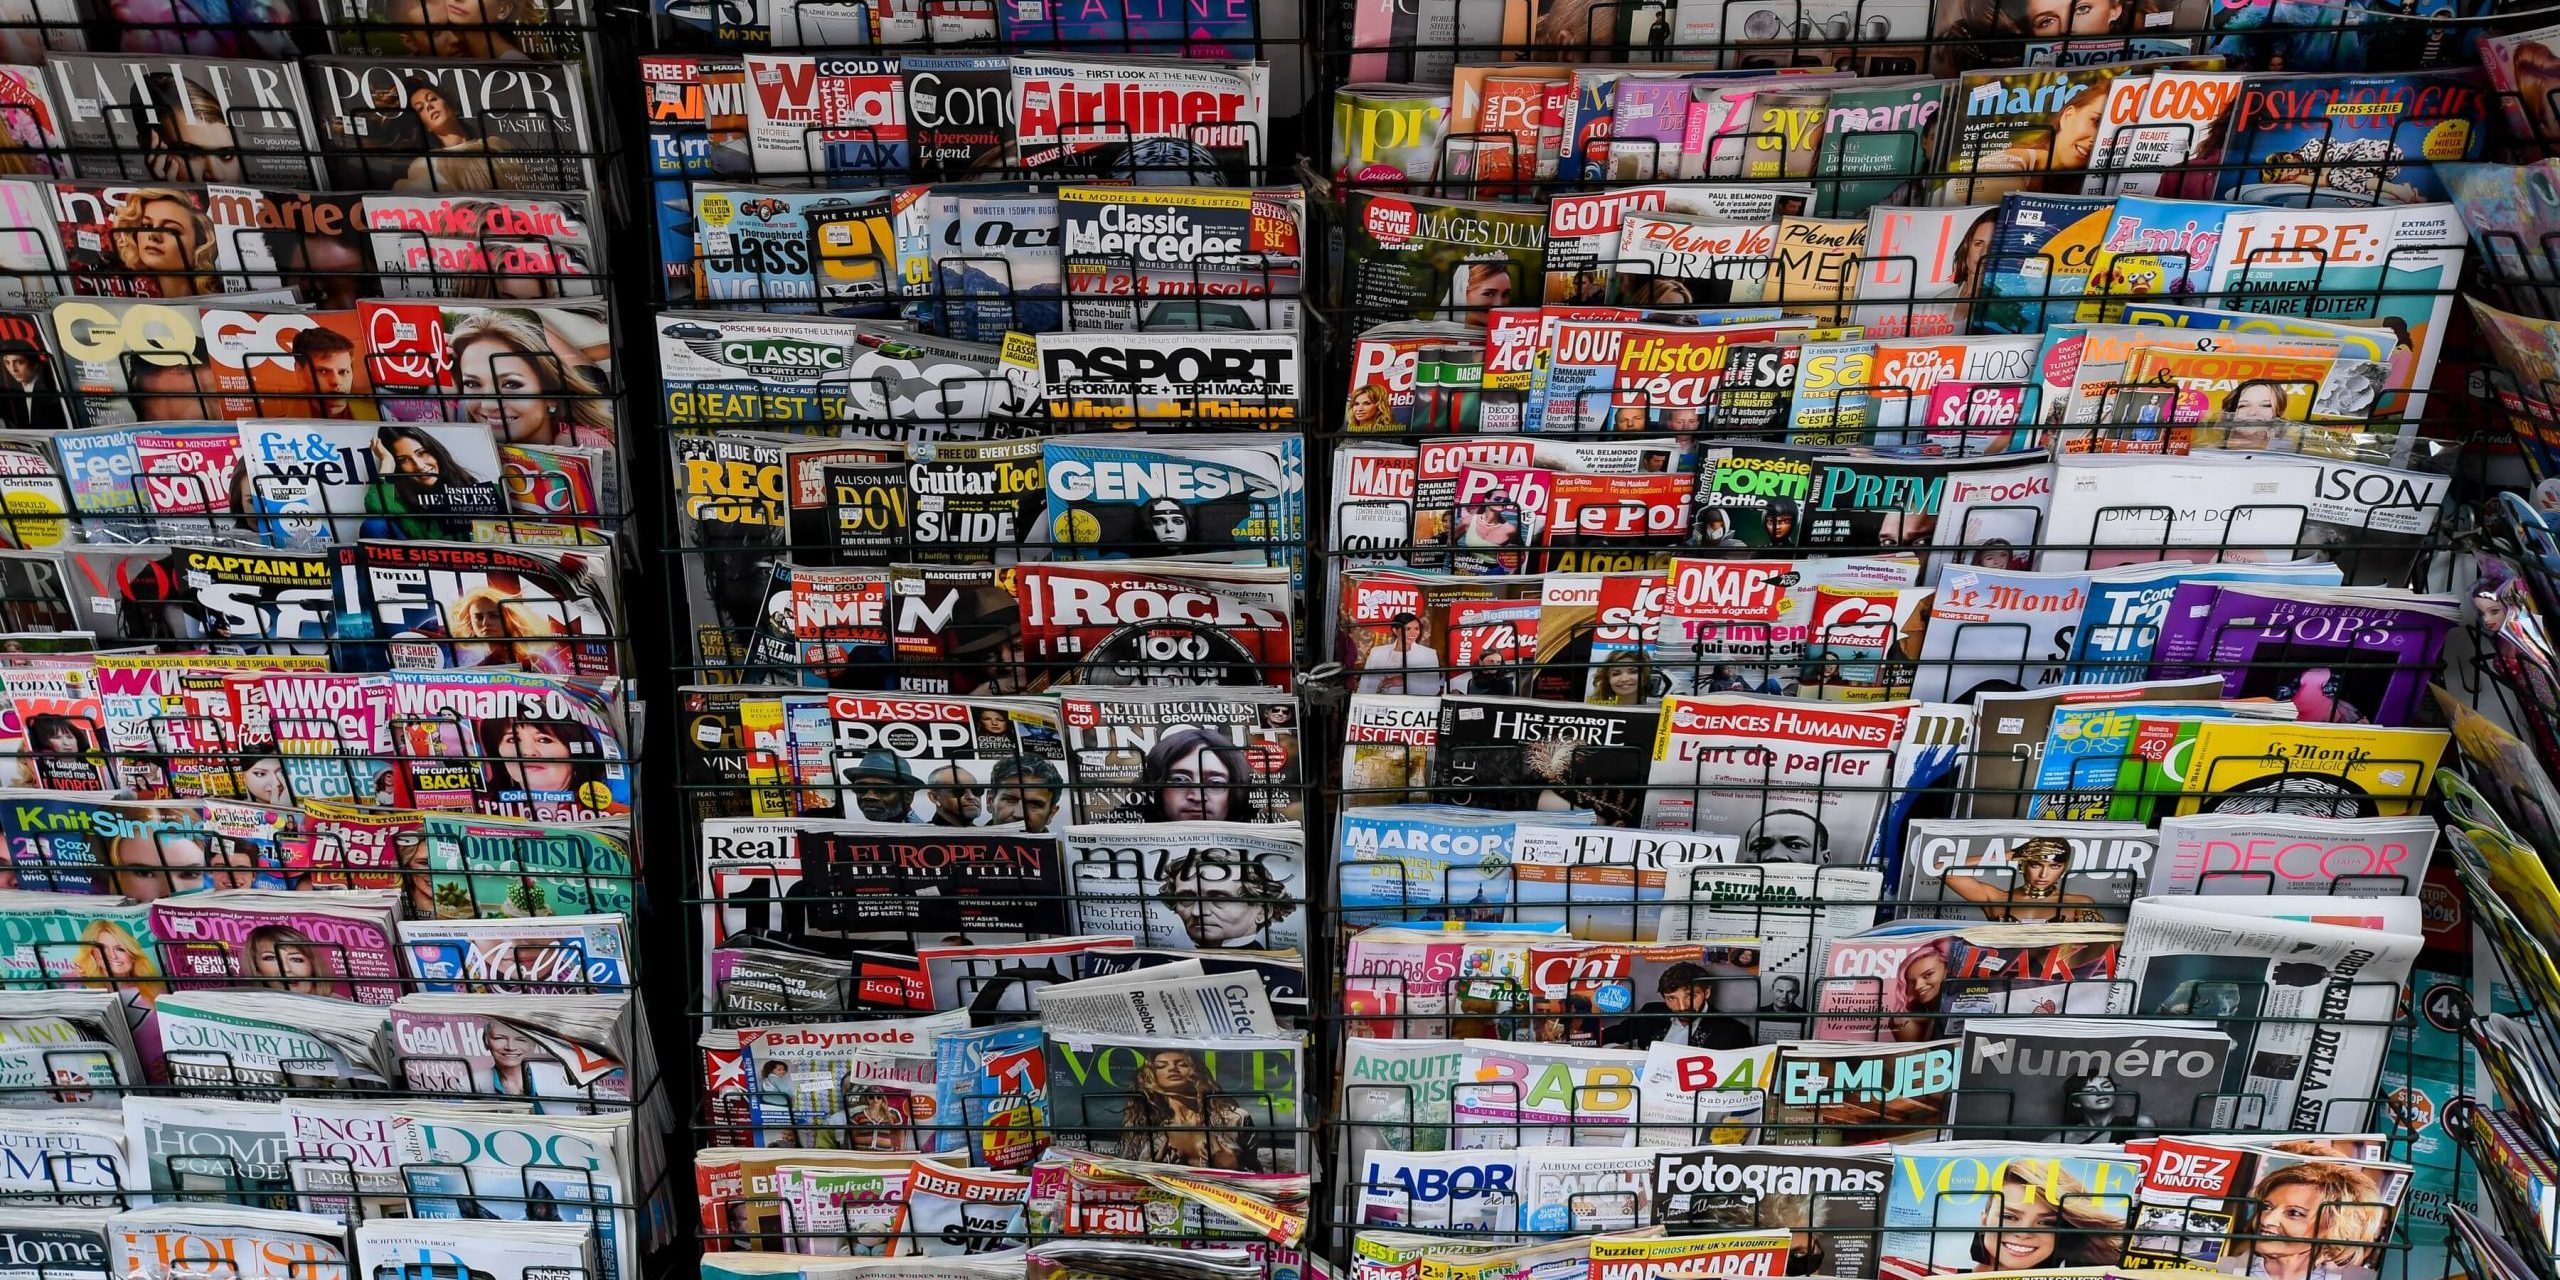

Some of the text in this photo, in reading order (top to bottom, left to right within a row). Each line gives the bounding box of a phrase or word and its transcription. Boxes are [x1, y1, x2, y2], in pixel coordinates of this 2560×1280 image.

[644, 63, 682, 81] FREE
[832, 60, 888, 75] COLD
[908, 58, 987, 69] CELEBRATING 50
[1012, 65, 1242, 87] AER LINGUS FIRST LOOK AT THE NEW LIVERY
[47, 60, 297, 128] TATLER
[1019, 80, 1245, 138] Airliner
[1827, 93, 1940, 134] marie
[2330, 102, 2400, 114] HORS-SÉRIE
[757, 128, 792, 138] TUTORIEL
[1170, 123, 1250, 148] World
[1687, 105, 1706, 151] Healthy
[2435, 138, 2461, 147] MIEUX
[1063, 191, 1245, 208] ALL MODELS & VALUES LISTED!
[1708, 192, 1773, 201] PAUL BELMONDO
[210, 193, 344, 237] marie
[845, 207, 890, 219] THRILL
[973, 206, 1037, 216] MONSTER 150MPH
[1100, 204, 1189, 234] Classic
[1369, 206, 1412, 222] POINT
[1254, 219, 1293, 237] R129
[1368, 219, 1411, 236] DE VUE
[1416, 212, 1525, 248] IMAGES DU
[2401, 219, 2446, 228] EXTRAITS
[740, 228, 804, 242] Thoroughbred
[1066, 218, 1242, 264] Mercedes
[1264, 234, 1285, 248] SL
[1639, 222, 1772, 255] Pleine Vie
[2395, 228, 2448, 237] EXCLUSIFS
[1379, 241, 1424, 252] Mariage
[2139, 258, 2184, 269] meilleurs
[2261, 299, 2299, 314] FAIRE
[53, 302, 204, 367] GQ
[91, 329, 116, 337] BRITISH
[720, 323, 756, 334] PORSCHE
[757, 325, 772, 334] 964
[772, 326, 804, 335] BUYING
[805, 327, 819, 336] THE
[368, 305, 453, 380] Red
[724, 343, 843, 369] CLASSIC
[926, 347, 959, 360] FERRARI
[1906, 350, 1939, 367] TOP
[752, 366, 818, 377] & SPORTS CAR
[1553, 367, 1597, 377] EMMANUEL
[2150, 357, 2327, 382] MODES
[1552, 374, 1586, 384] MACRON
[1880, 361, 1955, 396] Santé
[670, 393, 808, 418] GREATEST
[140, 439, 227, 448] HEALTH MINDSET
[719, 443, 751, 463] BLUE
[264, 446, 381, 486] well
[4, 479, 53, 488] Christmas
[149, 455, 234, 507] Santé
[834, 475, 881, 486] ALLISON
[1048, 460, 1281, 501] GENESIS
[1551, 498, 1606, 531] Le
[2105, 509, 2254, 521] DIM DAM DOM
[365, 547, 487, 564] THE SISTERS
[189, 554, 304, 577] CAPTAIN
[1847, 564, 1894, 574] Imprimante
[373, 571, 422, 582] TOTAL
[794, 573, 882, 583] PAUL SIMONON ON
[1860, 571, 1907, 583] intelligents
[1222, 587, 1267, 598] Contents
[1676, 564, 1779, 608] OKAPI
[796, 601, 884, 627] NME
[1938, 611, 1986, 622] HORS-SÉRIE
[2259, 612, 2395, 645] L'OBS
[9, 681, 64, 691] TODAY
[393, 674, 543, 686] WHY FRIENDS CAN ADD YEARS
[900, 677, 949, 693] KEITH
[835, 698, 964, 722] CLASSIC
[1067, 703, 1092, 713] FREE
[1100, 702, 1255, 716] KEITH RICHARDS
[1068, 713, 1093, 725] CD!
[1100, 713, 1255, 724] "I'M STILL GROWING UP!"
[1524, 712, 1607, 727] LE FIGARO
[1675, 705, 1887, 742] SCIENCES HUMAINES
[1493, 710, 1627, 747] HISTOIRE
[838, 722, 970, 760] POP
[978, 735, 1010, 743] GLORIA
[979, 741, 1016, 750] ESTEFAN
[2139, 739, 2168, 753] 40
[1679, 740, 1871, 776] L'art de parler
[2267, 742, 2371, 763] Le Monde
[421, 774, 478, 790] BACK!
[542, 792, 573, 802] fears
[316, 823, 419, 847] that's
[1068, 835, 1096, 843] BBC
[54, 839, 91, 852] Cozy
[709, 836, 791, 860] Real
[57, 848, 97, 862] Knits
[2200, 837, 2409, 883] DECOR
[1072, 847, 1297, 882] music
[557, 887, 630, 907] Save
[1080, 904, 1159, 920] The French
[1081, 918, 1175, 936] revolutionary
[467, 941, 613, 996] Mollie
[1535, 952, 1628, 998] Chi
[170, 1026, 281, 1055] COUNTRY
[397, 1019, 450, 1055] Good
[766, 1028, 915, 1050] Babymode
[1970, 1036, 2216, 1079] Numéro
[855, 1060, 912, 1083] Diana
[418, 1124, 601, 1172] DOG
[2157, 1149, 2232, 1181] DIEZ
[308, 1172, 400, 1188] LABOURS
[819, 1180, 882, 1194] einfach
[915, 1173, 960, 1196] DER
[1656, 1155, 1886, 1204] Fotogramas
[1896, 1156, 2138, 1208] VOGUE
[2152, 1170, 2222, 1191] MINUTOS
[2410, 1204, 2450, 1226] Lucky
[1358, 1241, 1488, 1262] BEST FOR PUZZLES
[1595, 1245, 1645, 1258] Puzzler
[1651, 1243, 1687, 1255] CHOOSE
[1688, 1243, 1707, 1253] THE
[1727, 1238, 1781, 1251] FAVOURITE
